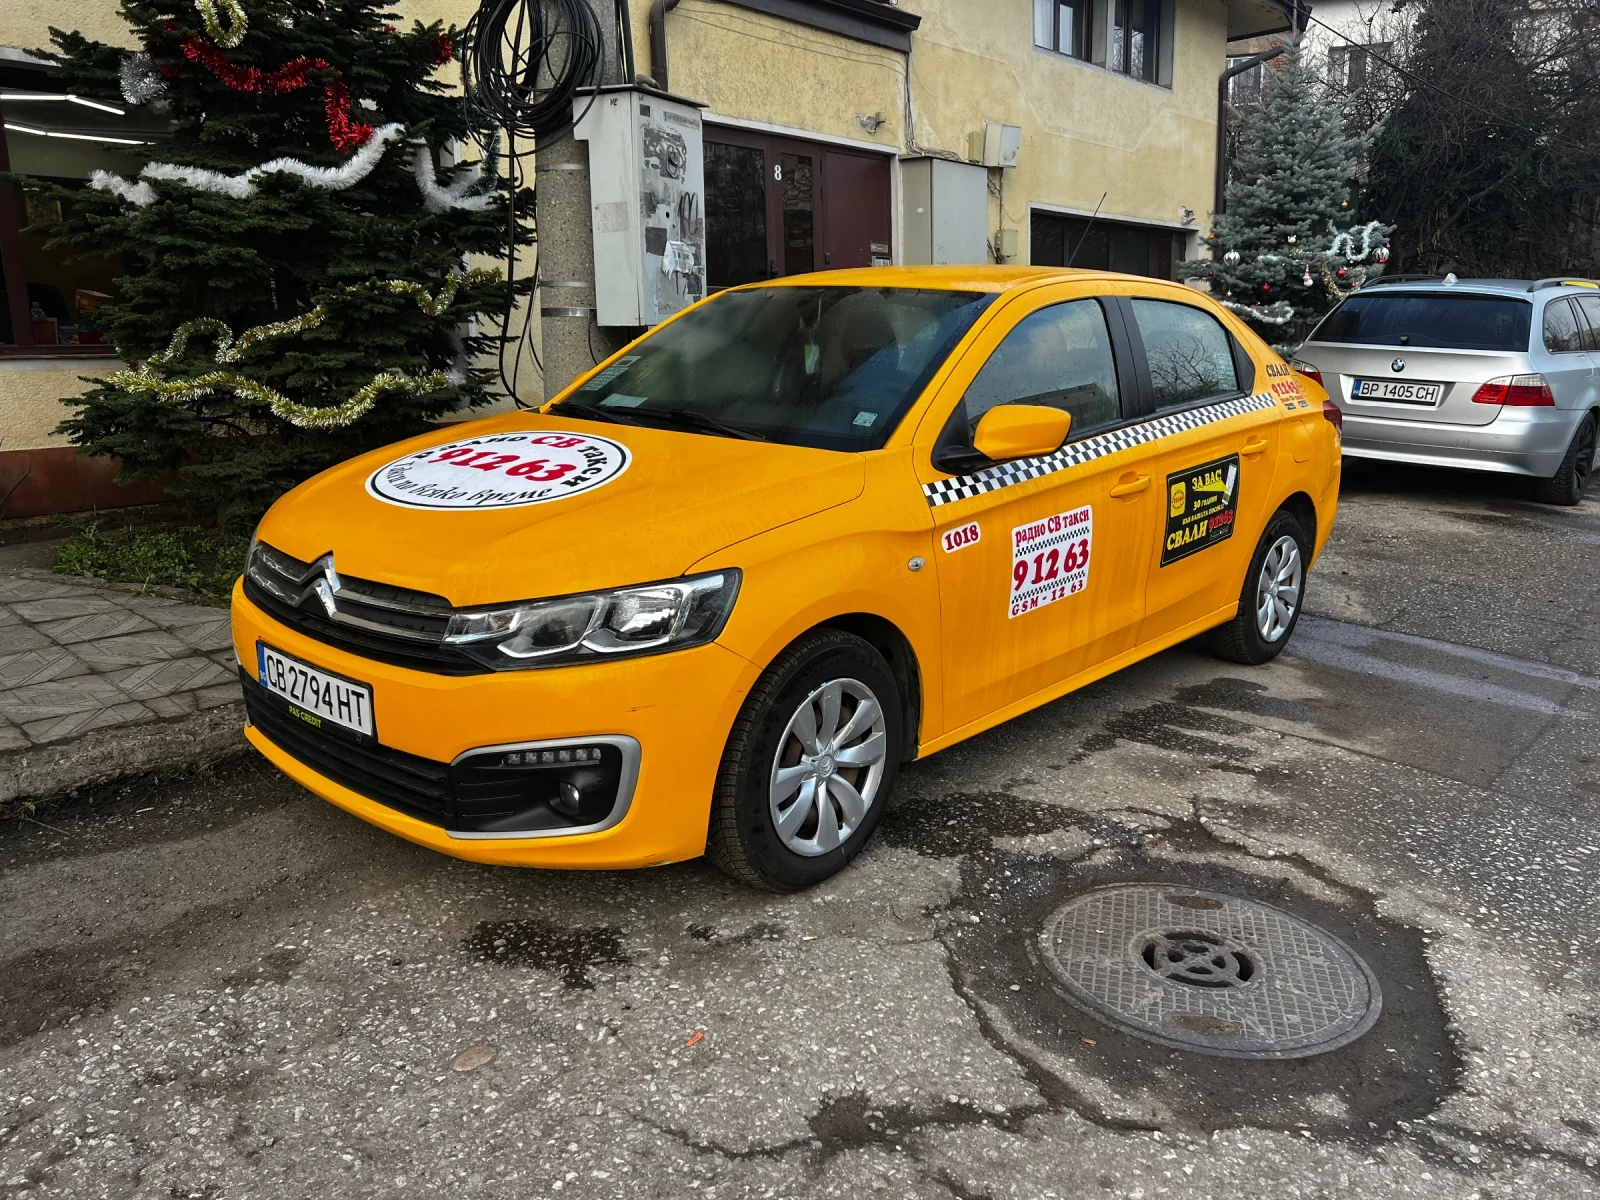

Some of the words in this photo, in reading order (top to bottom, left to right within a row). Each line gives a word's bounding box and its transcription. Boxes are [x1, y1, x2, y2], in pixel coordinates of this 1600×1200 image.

[774, 164, 782, 181] 8
[1271, 380, 1300, 398] 91263
[1383, 384, 1414, 398] 1405
[560, 445, 608, 487] такси
[1191, 476, 1204, 490] ЗА
[466, 488, 553, 505] време
[1015, 523, 1046, 548] радио
[1047, 515, 1062, 534] СВ
[1062, 508, 1090, 528] такси
[1208, 509, 1234, 533] 91263
[944, 524, 979, 551] 1018
[300, 711, 322, 728] CREDIT
